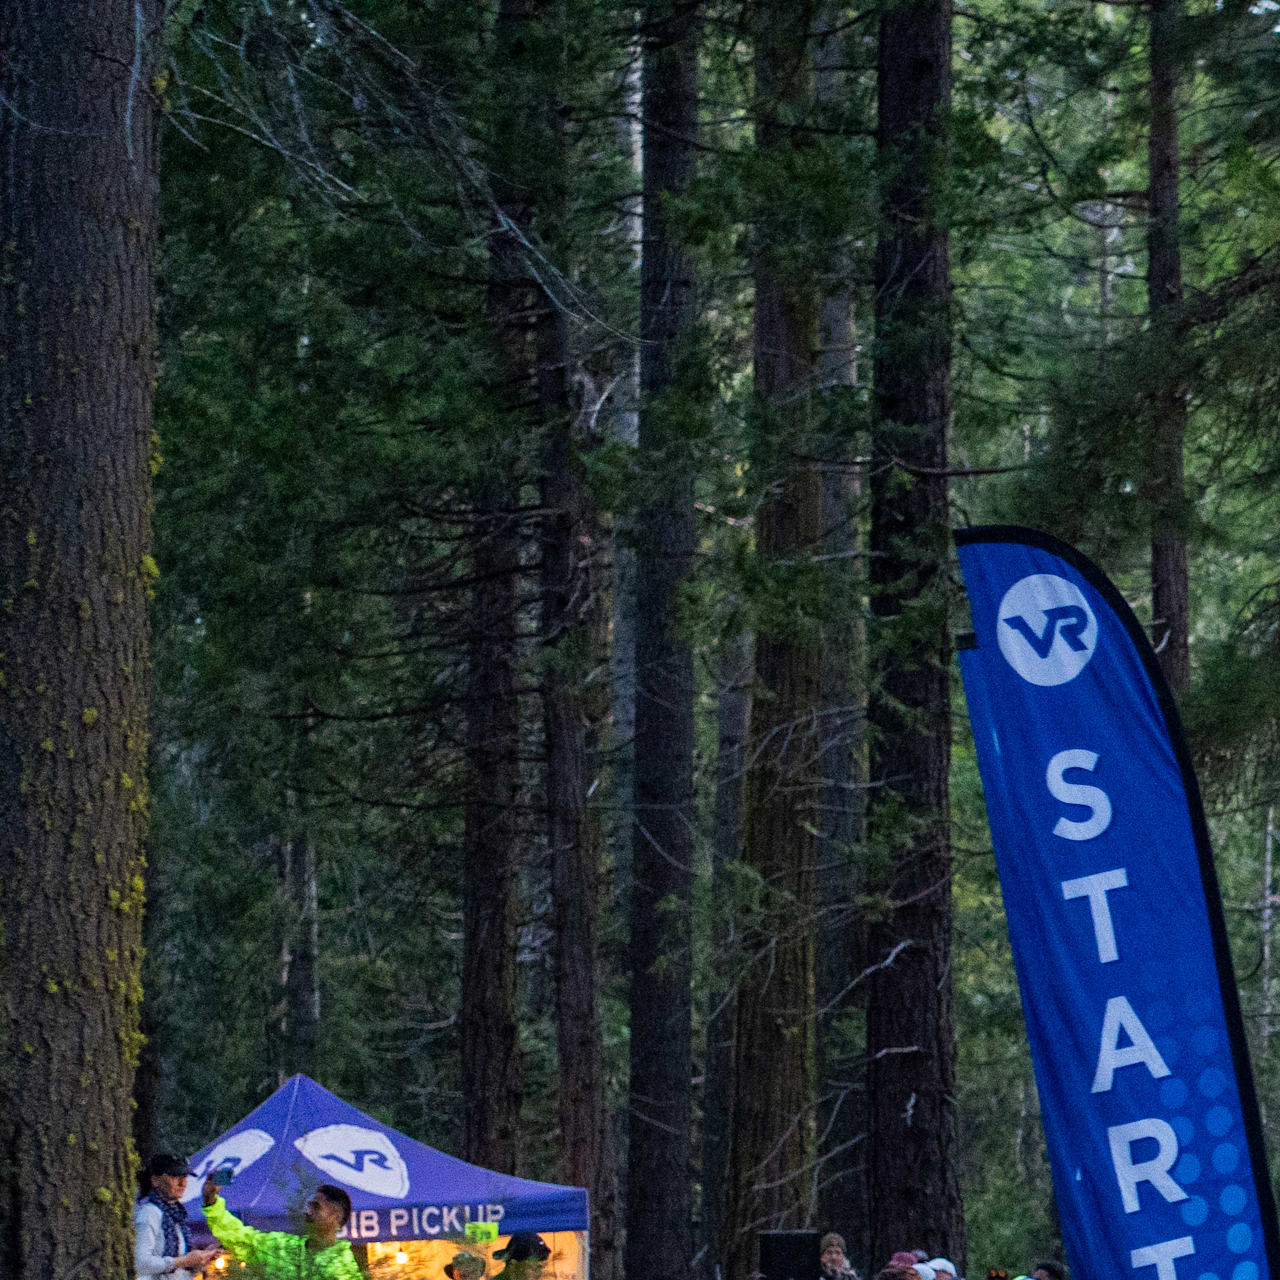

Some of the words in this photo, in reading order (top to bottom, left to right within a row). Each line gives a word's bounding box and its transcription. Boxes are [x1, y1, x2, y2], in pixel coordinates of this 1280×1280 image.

[1002, 604, 1090, 659] VR
[318, 1149, 393, 1174] VR
[336, 1209, 380, 1239] IB
